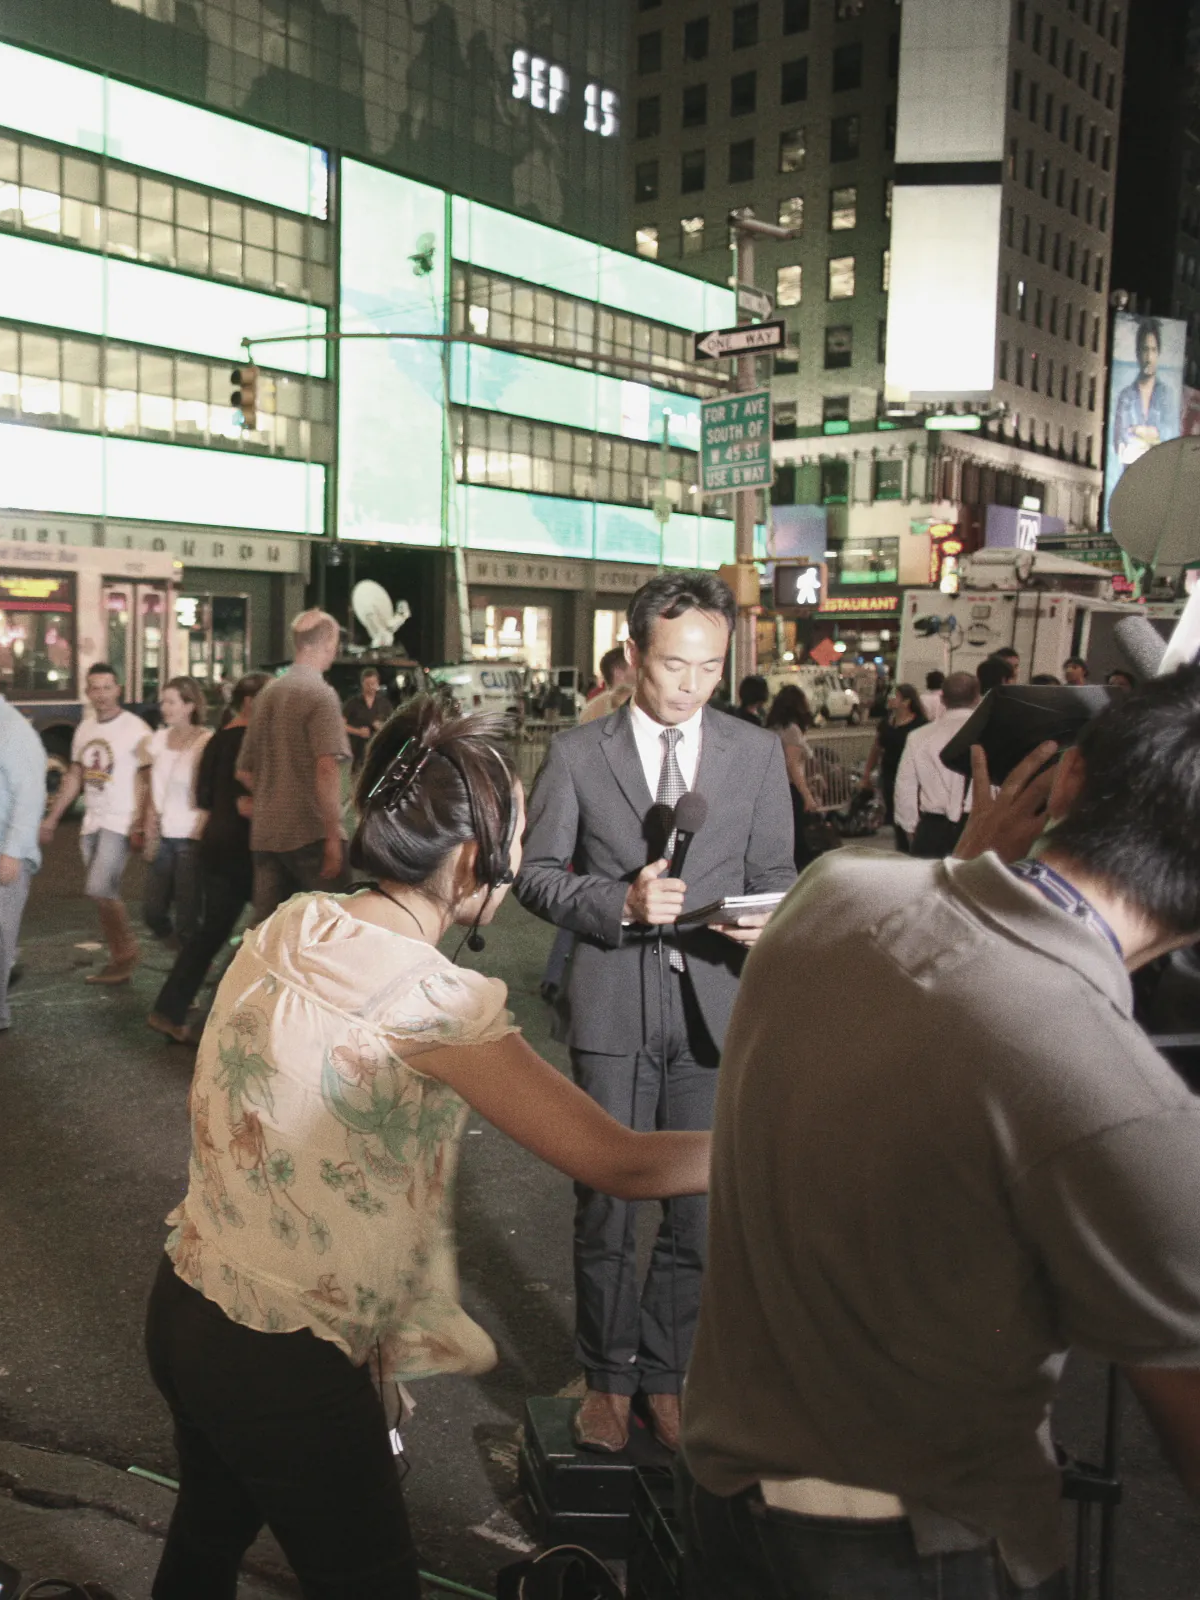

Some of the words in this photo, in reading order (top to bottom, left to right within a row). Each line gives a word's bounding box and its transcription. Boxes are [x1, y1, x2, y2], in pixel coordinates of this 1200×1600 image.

[511, 49, 569, 114] SEP
[583, 83, 621, 136] 15
[707, 337, 732, 352] ONE
[746, 330, 774, 344] WAY
[705, 405, 726, 424] FOR
[731, 403, 739, 420] 7
[744, 397, 766, 416] AVE
[707, 424, 744, 445] SOUTH
[748, 419, 764, 438] OF
[710, 449, 720, 465] W
[724, 443, 741, 462] 45
[745, 442, 761, 459] ST
[705, 469, 728, 488] USE
